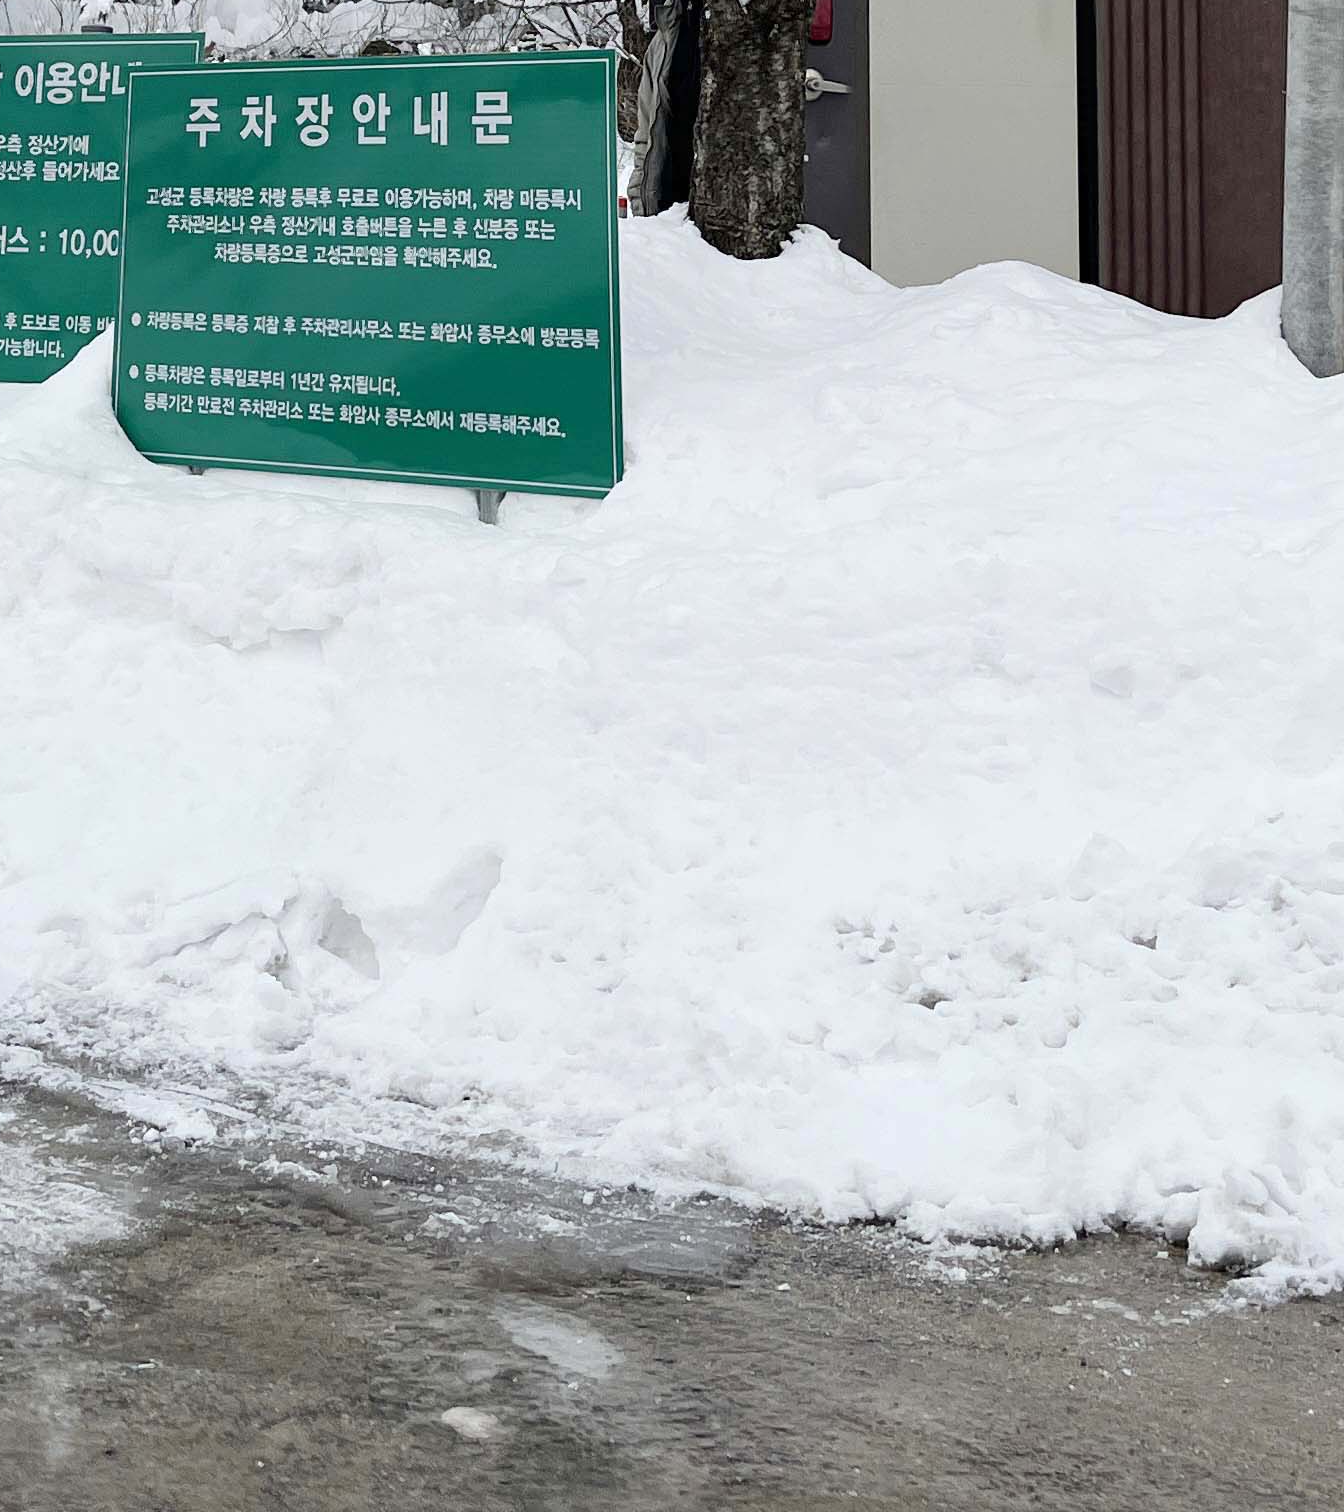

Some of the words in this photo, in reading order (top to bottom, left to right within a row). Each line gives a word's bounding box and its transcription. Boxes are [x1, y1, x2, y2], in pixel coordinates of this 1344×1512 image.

[27, 134, 90, 156] 정산기에
[42, 160, 121, 182] 들어가세요
[146, 187, 185, 207] 고성군
[189, 187, 255, 208] 등록차량은
[259, 187, 287, 208] 차량
[290, 187, 333, 208] 등록후
[336, 188, 380, 208] 무료로
[384, 187, 477, 210] 이용가능하며,
[483, 188, 515, 210] 차량
[519, 188, 581, 211] 미등록시
[166, 214, 246, 235] 주차관리소나
[249, 214, 277, 236] 우측
[281, 215, 336, 237] 정산기내
[340, 215, 413, 238] 호출버튼을
[417, 217, 448, 239] 누른
[452, 217, 469, 239] 후
[472, 218, 519, 241] 신분증
[524, 218, 556, 241] 또는
[214, 242, 309, 264] 차량등록증으로
[402, 246, 498, 269] 확인해주세요.
[3, 312, 18, 331] 후
[21, 314, 61, 331] 도보로
[65, 315, 92, 334] 이동
[146, 311, 208, 332] 차량등록은
[211, 313, 249, 334] 등록증
[253, 315, 280, 335] 지참
[282, 316, 297, 335] 후
[300, 317, 394, 339] 주차관리사무소
[397, 321, 426, 341] 또는
[430, 322, 473, 344] 화암사
[477, 324, 535, 346] 종무소에
[540, 327, 600, 350] 방문등록
[144, 364, 206, 385] 등록차량은
[209, 367, 285, 390] 등록일로부터
[290, 372, 325, 392] 1년간
[328, 373, 401, 397] 유지됩니다.
[143, 392, 194, 413] 등록기간
[197, 395, 235, 416] 만료전
[238, 398, 304, 420] 주차관리소
[307, 403, 335, 422] 또는
[339, 404, 381, 426] 화암사
[384, 407, 454, 431] 종무소에서
[459, 412, 566, 438] 재등록해주세요.
